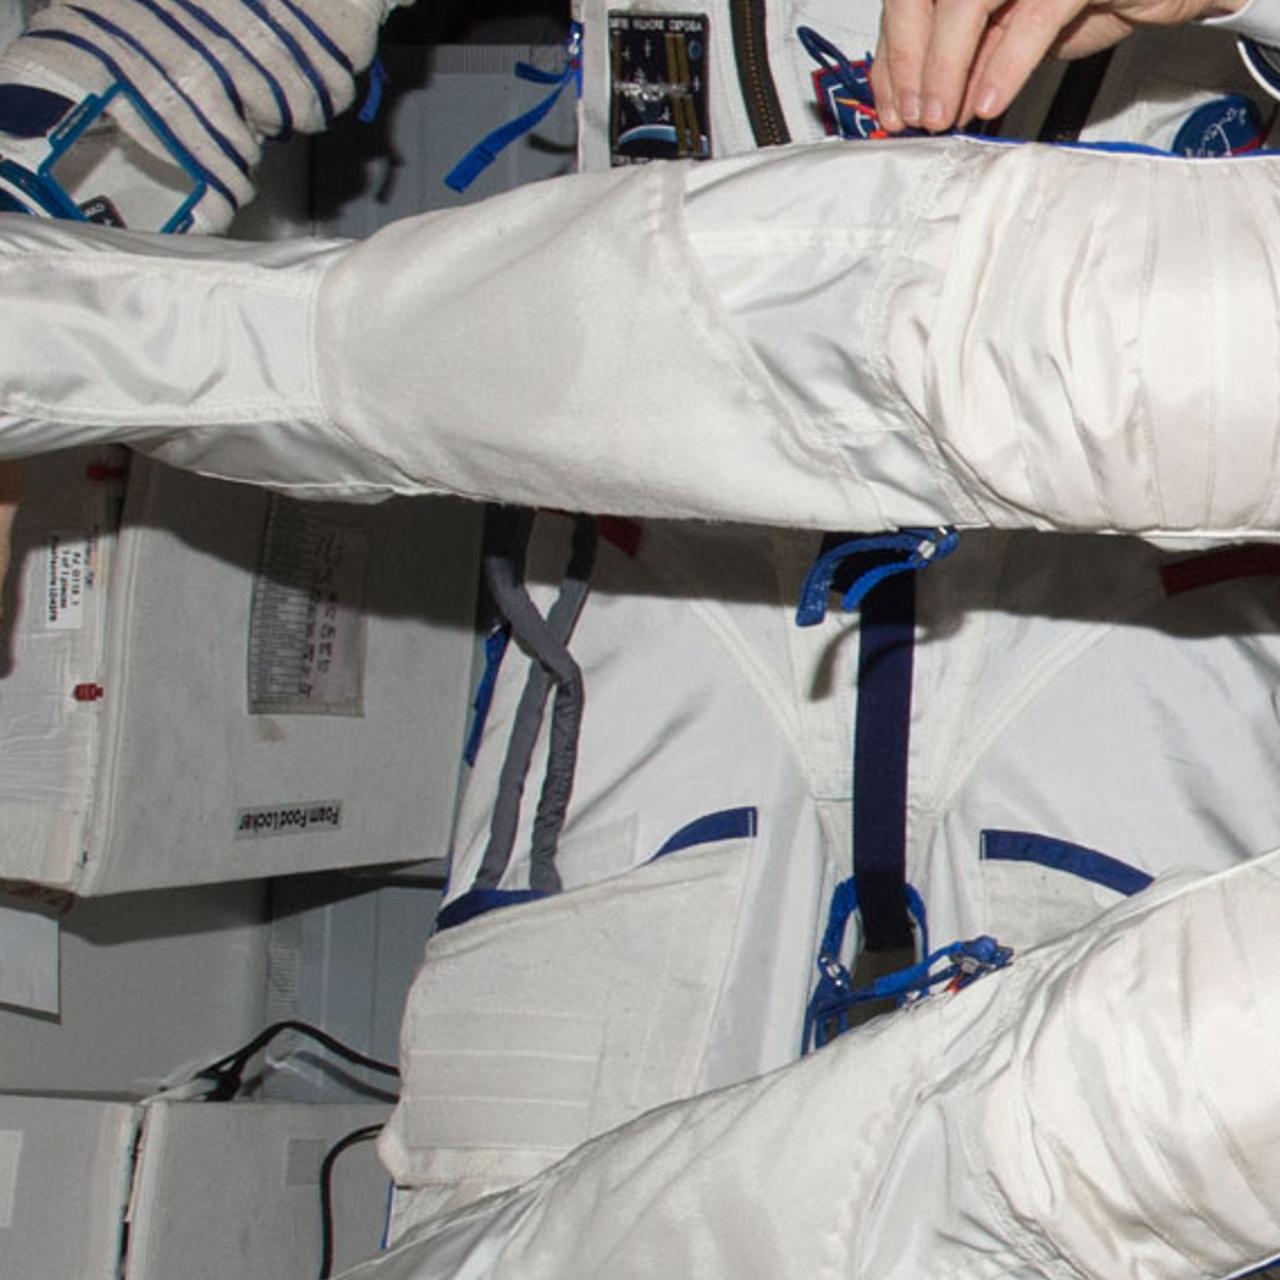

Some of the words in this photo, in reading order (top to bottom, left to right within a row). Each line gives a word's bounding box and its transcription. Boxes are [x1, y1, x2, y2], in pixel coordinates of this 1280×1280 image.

[238, 810, 279, 831] Locker
[280, 807, 307, 829] Food
[308, 805, 339, 826] Foam
